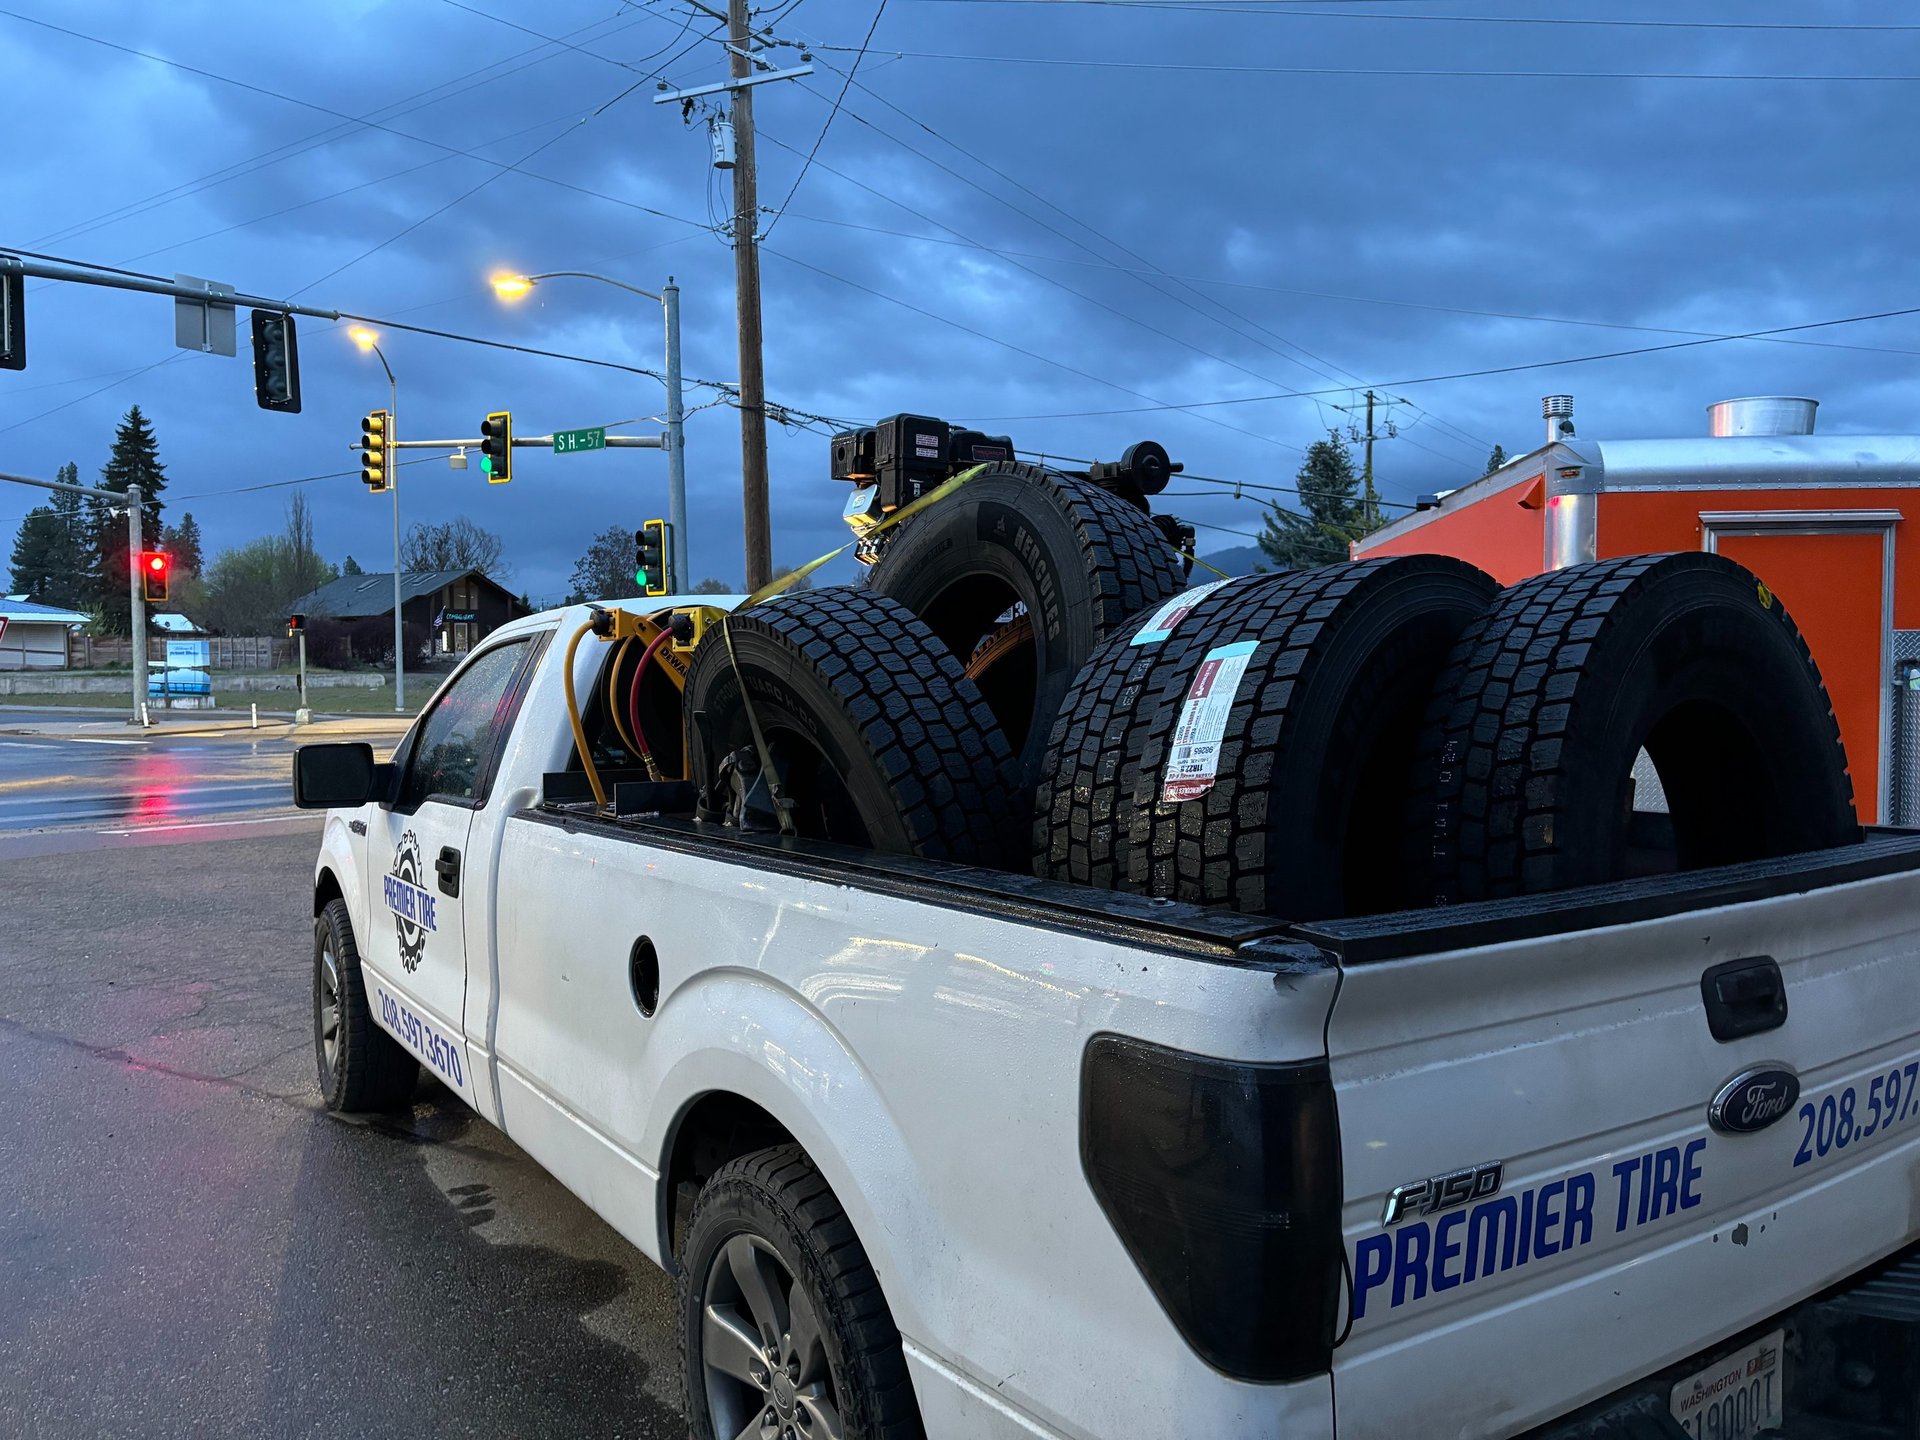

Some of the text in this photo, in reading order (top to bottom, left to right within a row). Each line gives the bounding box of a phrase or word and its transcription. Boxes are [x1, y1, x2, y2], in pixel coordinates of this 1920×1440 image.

[1014, 525, 1061, 641] HERCULES
[1180, 764, 1203, 773] 11R22.5
[384, 875, 437, 931] PREMIER TIRE
[378, 988, 463, 1087] 208.597.3670
[1742, 1081, 1789, 1122] Ford
[1353, 1061, 1919, 1321] PREMIER TIRE 208.597.
[1382, 1160, 1503, 1227] F-150
[1681, 1368, 1742, 1413] WASHINGTON
